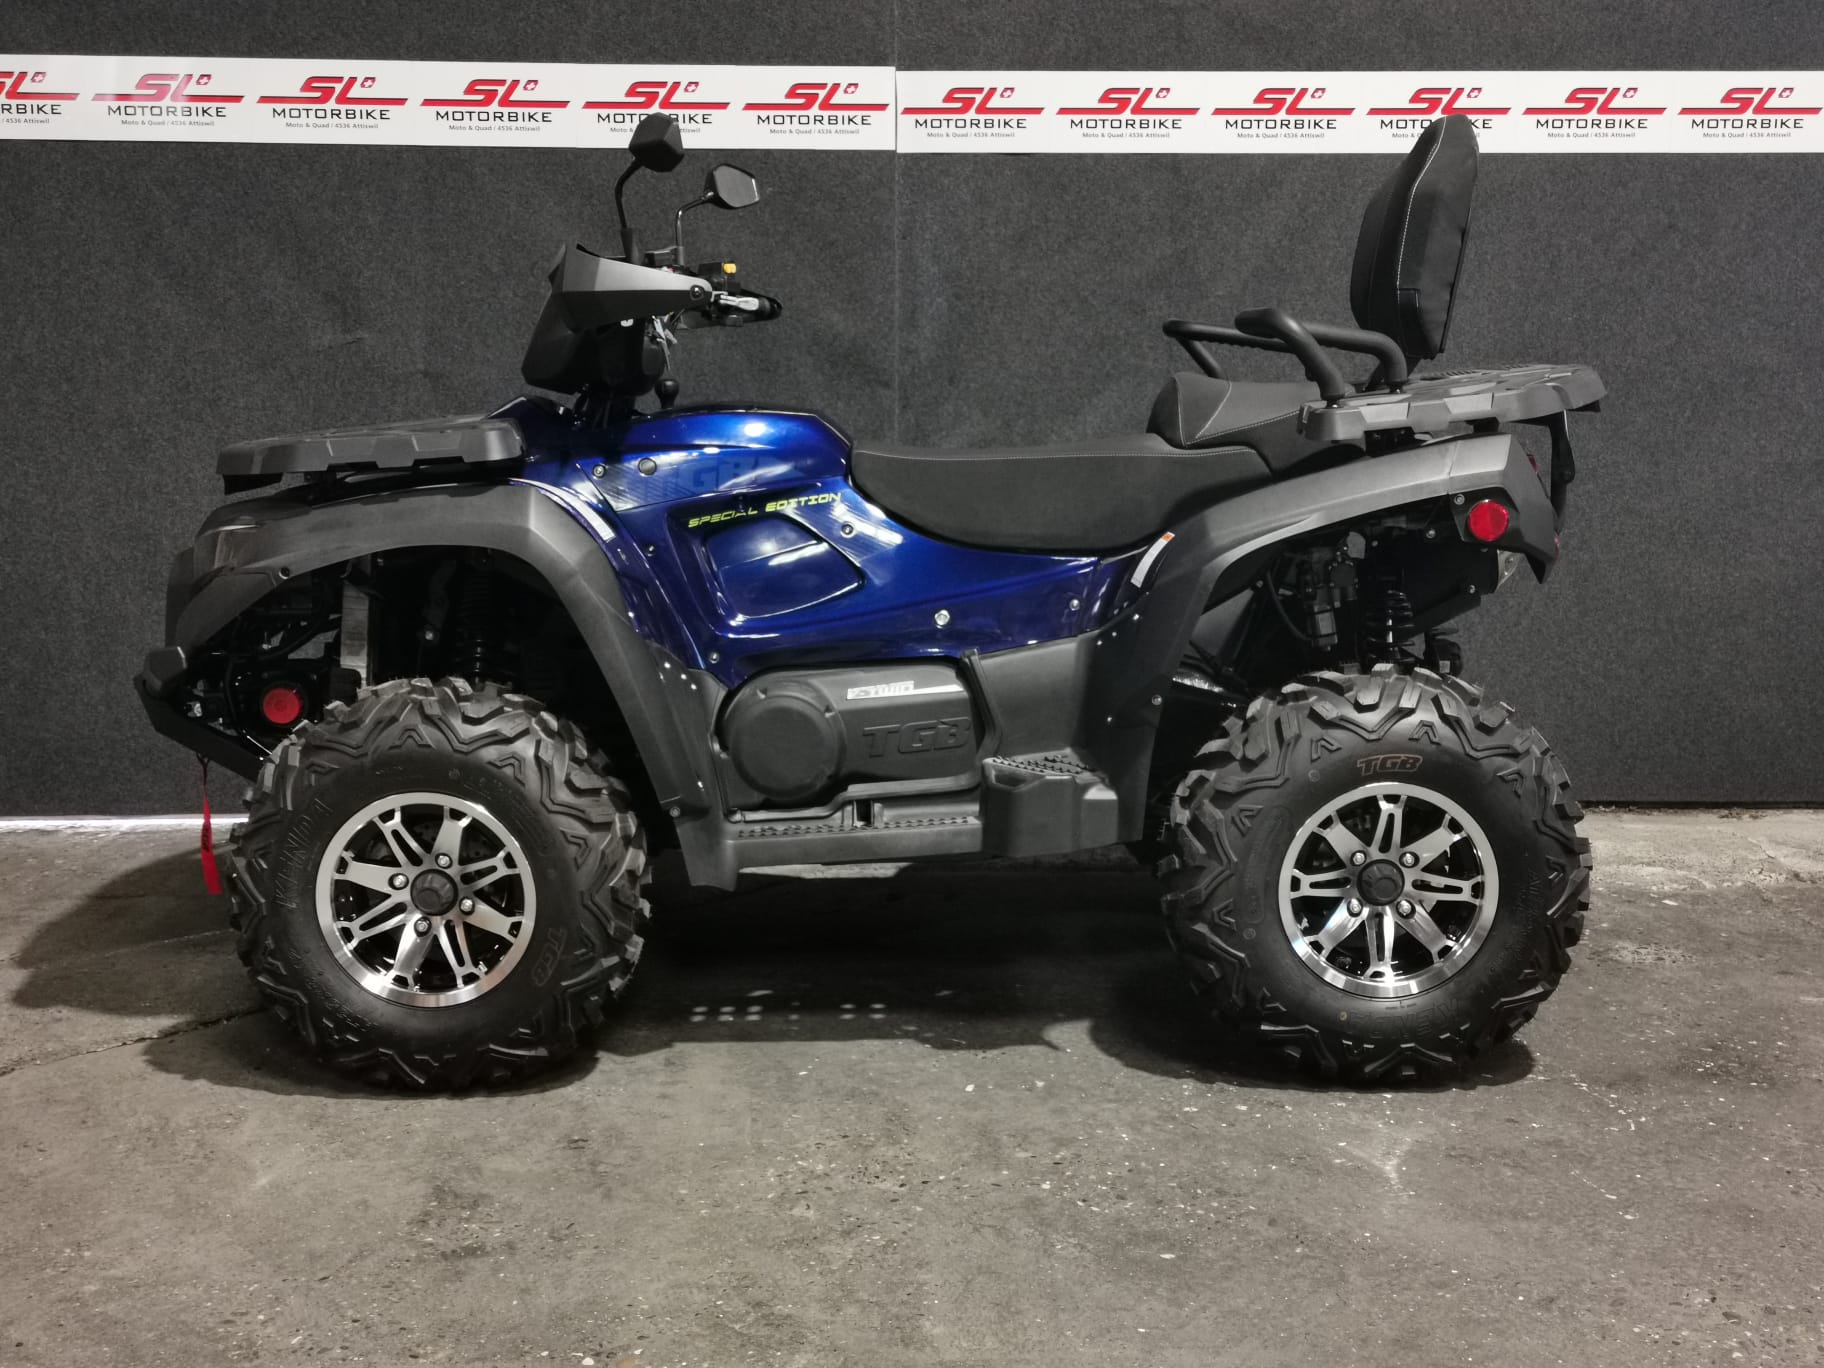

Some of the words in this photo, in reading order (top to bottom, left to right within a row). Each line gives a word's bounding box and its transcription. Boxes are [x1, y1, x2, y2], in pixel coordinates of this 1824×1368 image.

[1, 103, 62, 115] RBIKE
[107, 105, 227, 117] MOTORBIKE
[272, 107, 391, 120] MOTORBIKE
[435, 110, 552, 123] MOTORBIKE
[597, 112, 713, 125] MOTBIKE
[757, 114, 872, 126] MOTORBIKE
[121, 119, 139, 127] Moto
[148, 119, 165, 127] Quad
[914, 118, 1027, 129] MOTORBIKE
[1070, 118, 1182, 129] MOTORBIKE
[1225, 118, 1337, 129] MOTORBIKE
[1380, 118, 1493, 130] MOTOKE
[1536, 118, 1648, 129] MOTORBIKE
[1691, 118, 1804, 129] MOTORBIKE
[688, 507, 759, 528] SPECIAL
[765, 492, 842, 513] EDITION
[861, 716, 971, 758] TGB
[1356, 753, 1424, 777] TGB
